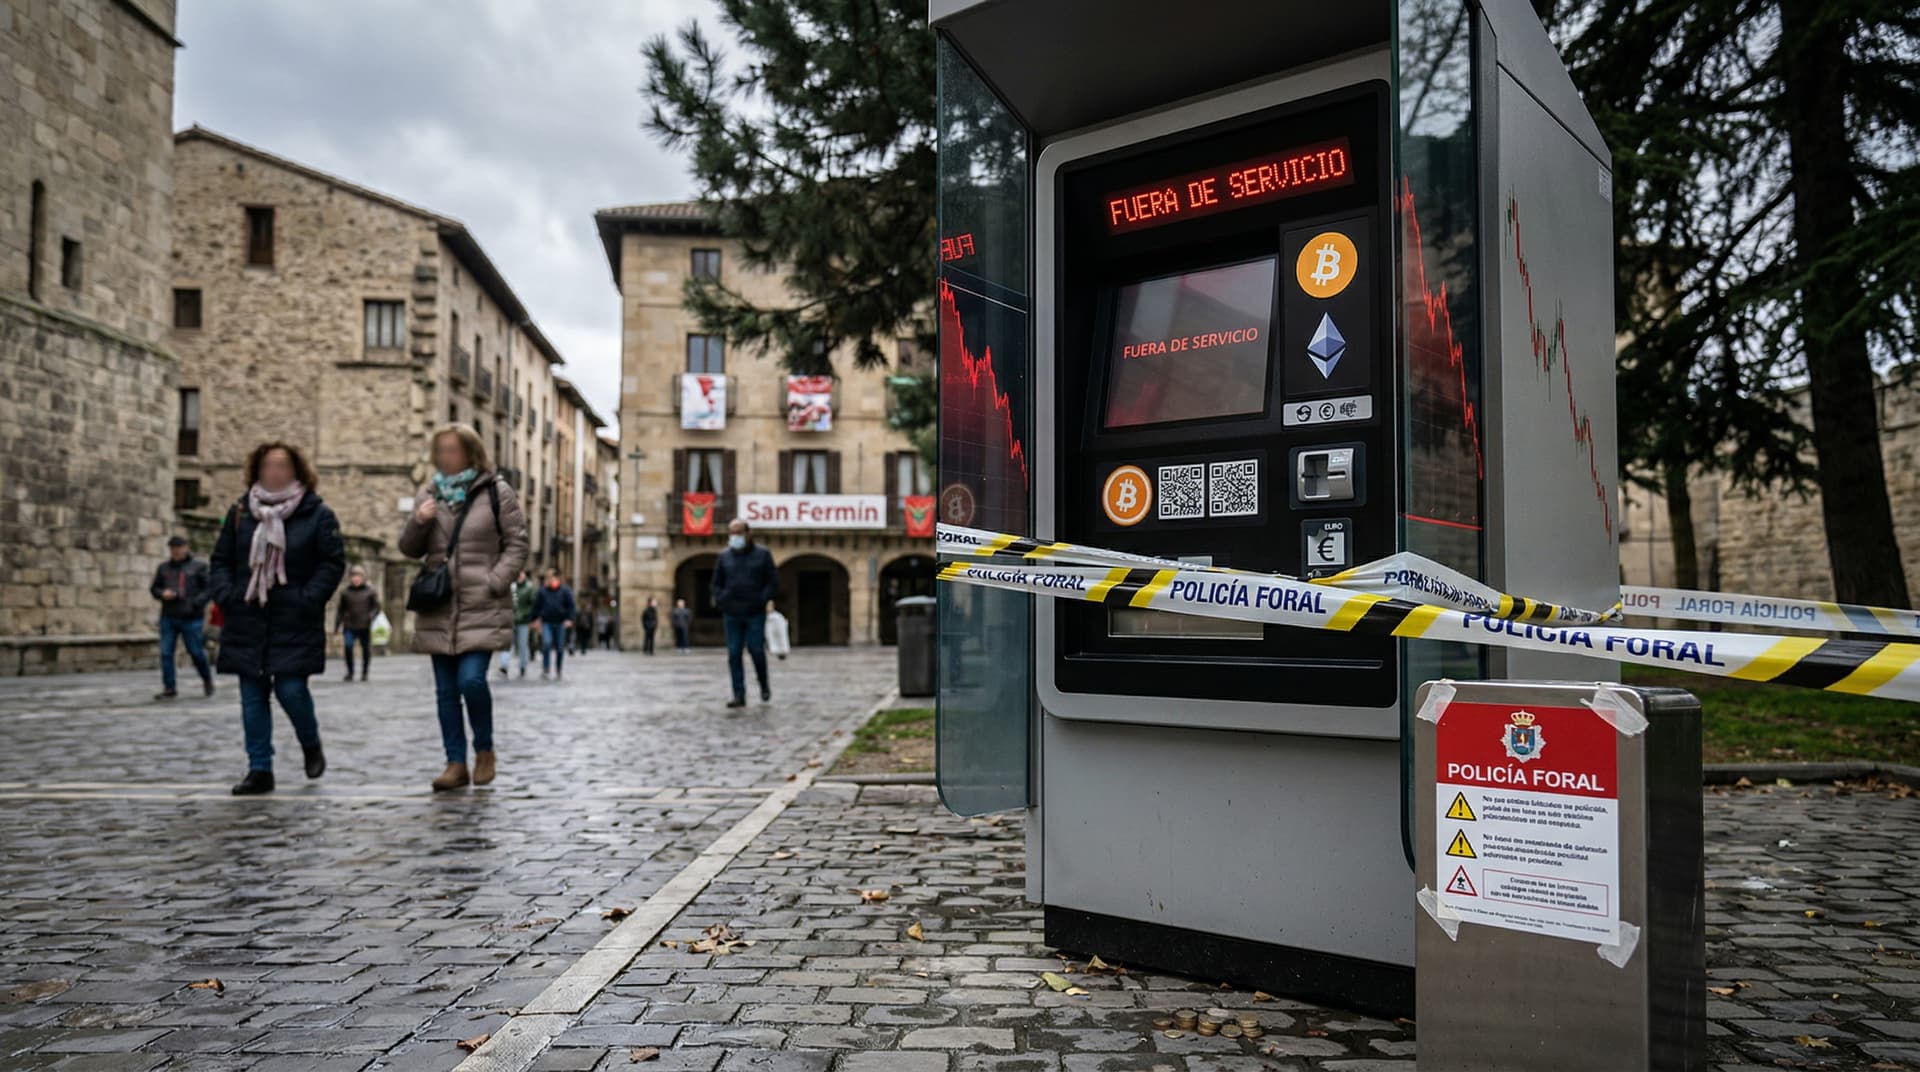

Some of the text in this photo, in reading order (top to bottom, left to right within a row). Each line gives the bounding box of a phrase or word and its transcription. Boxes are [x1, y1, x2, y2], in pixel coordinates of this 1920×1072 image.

[1110, 148, 1346, 226] FUERA DE SERVICIO
[1123, 327, 1259, 359] FUERA DE SERVICIO
[746, 500, 879, 522] San Fermín
[1324, 522, 1343, 530] EURO
[1169, 579, 1327, 614] POLICÍA FORAL
[1605, 635, 1725, 667] FORAL
[1448, 763, 1605, 792] POLICÍA FORAL
